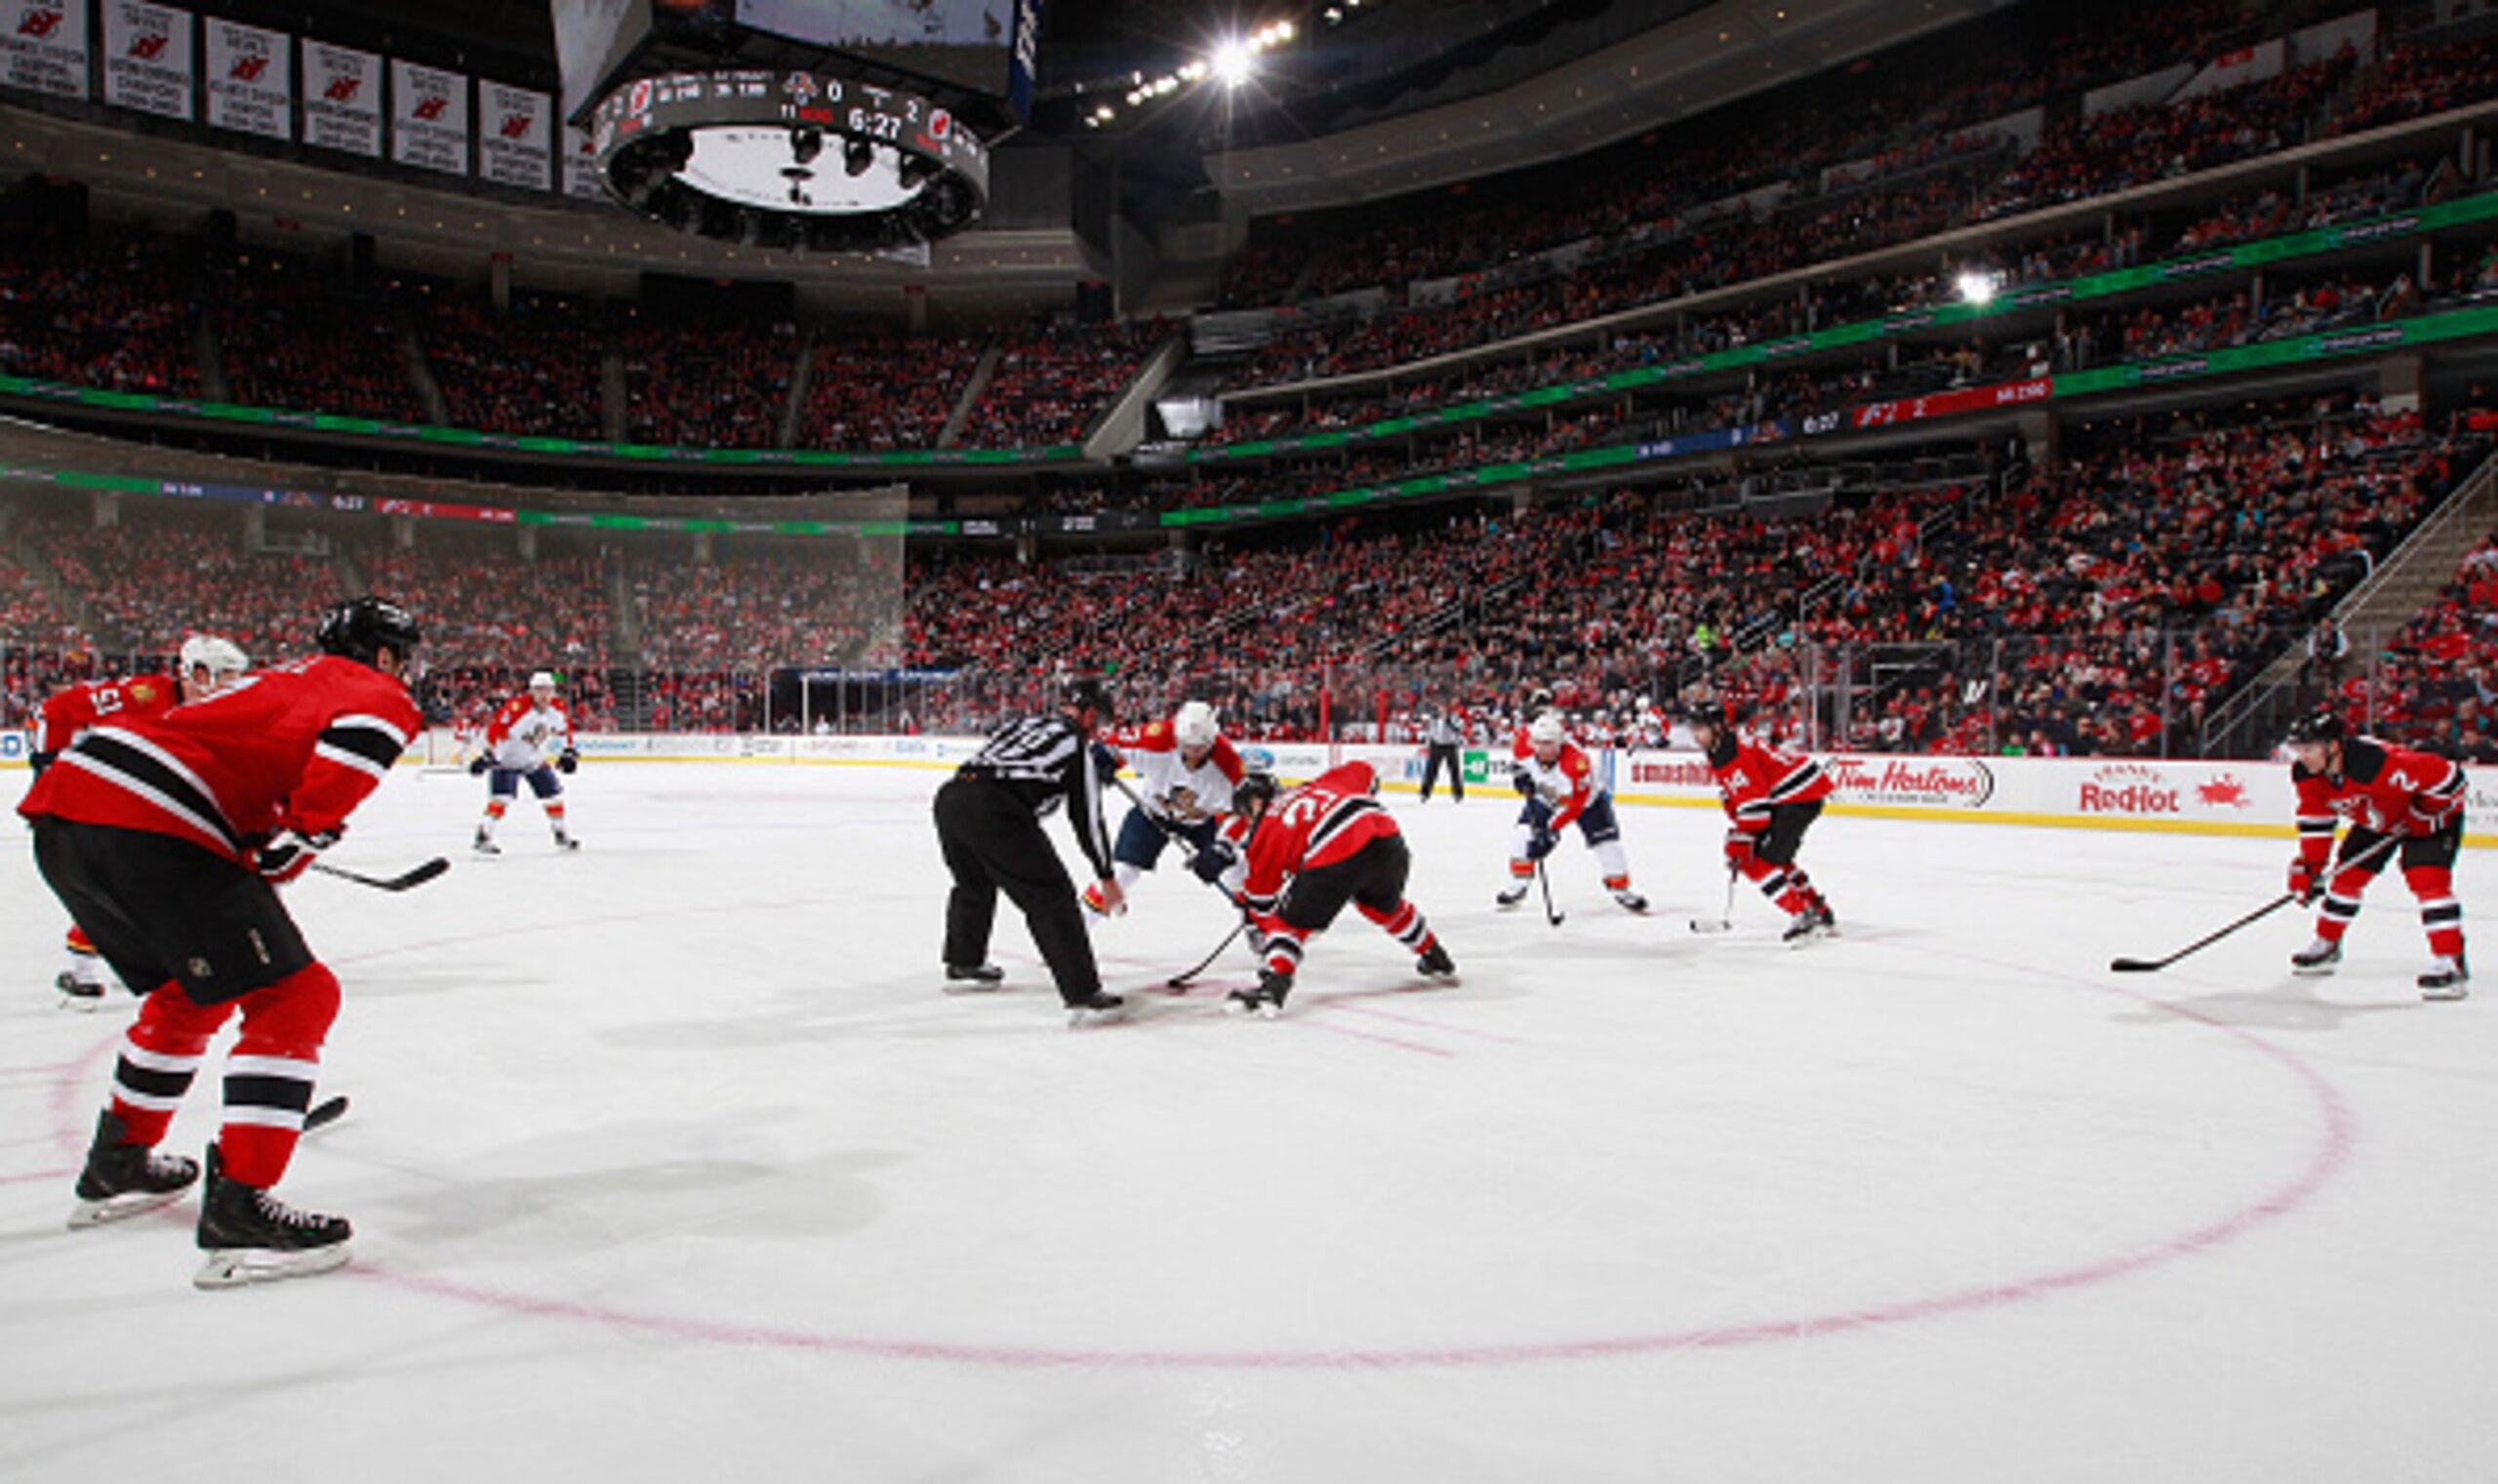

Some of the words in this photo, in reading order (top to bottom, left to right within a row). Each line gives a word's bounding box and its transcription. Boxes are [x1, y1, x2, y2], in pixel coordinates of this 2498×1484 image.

[827, 81, 842, 101] 0
[849, 108, 902, 140] 6:27
[1834, 760, 1876, 788] Tim
[1879, 759, 1978, 794] Hortons
[2387, 769, 2420, 792] 2
